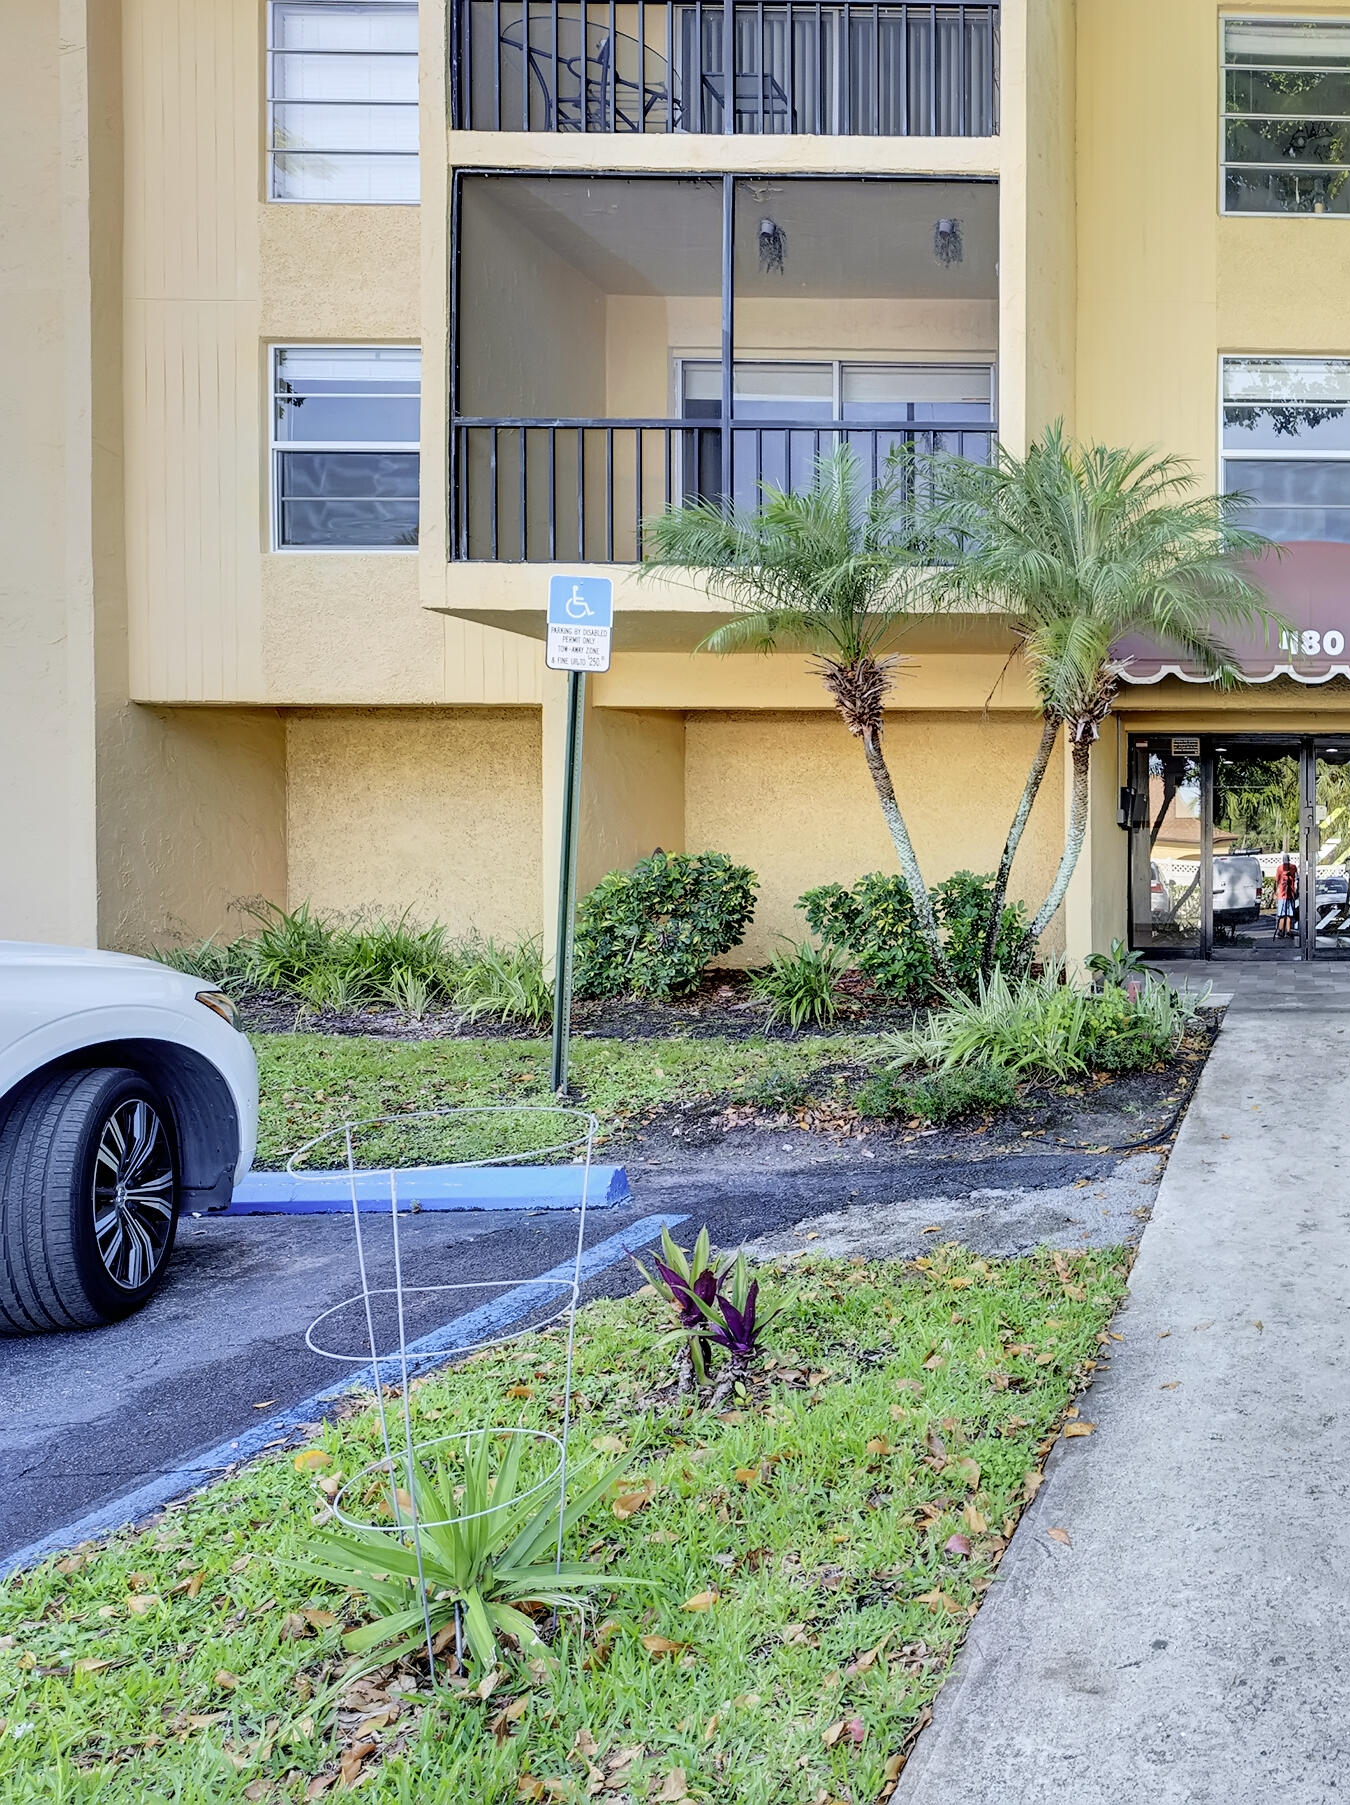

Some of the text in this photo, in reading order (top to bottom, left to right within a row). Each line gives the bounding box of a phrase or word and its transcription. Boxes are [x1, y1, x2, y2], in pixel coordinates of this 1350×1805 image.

[551, 627, 572, 635] PARKING
[583, 628, 607, 636] DISABLED
[562, 635, 595, 645] PERMIT ONLY
[558, 645, 600, 655] TOW-AWAY ZONE
[558, 656, 569, 664] FINE
